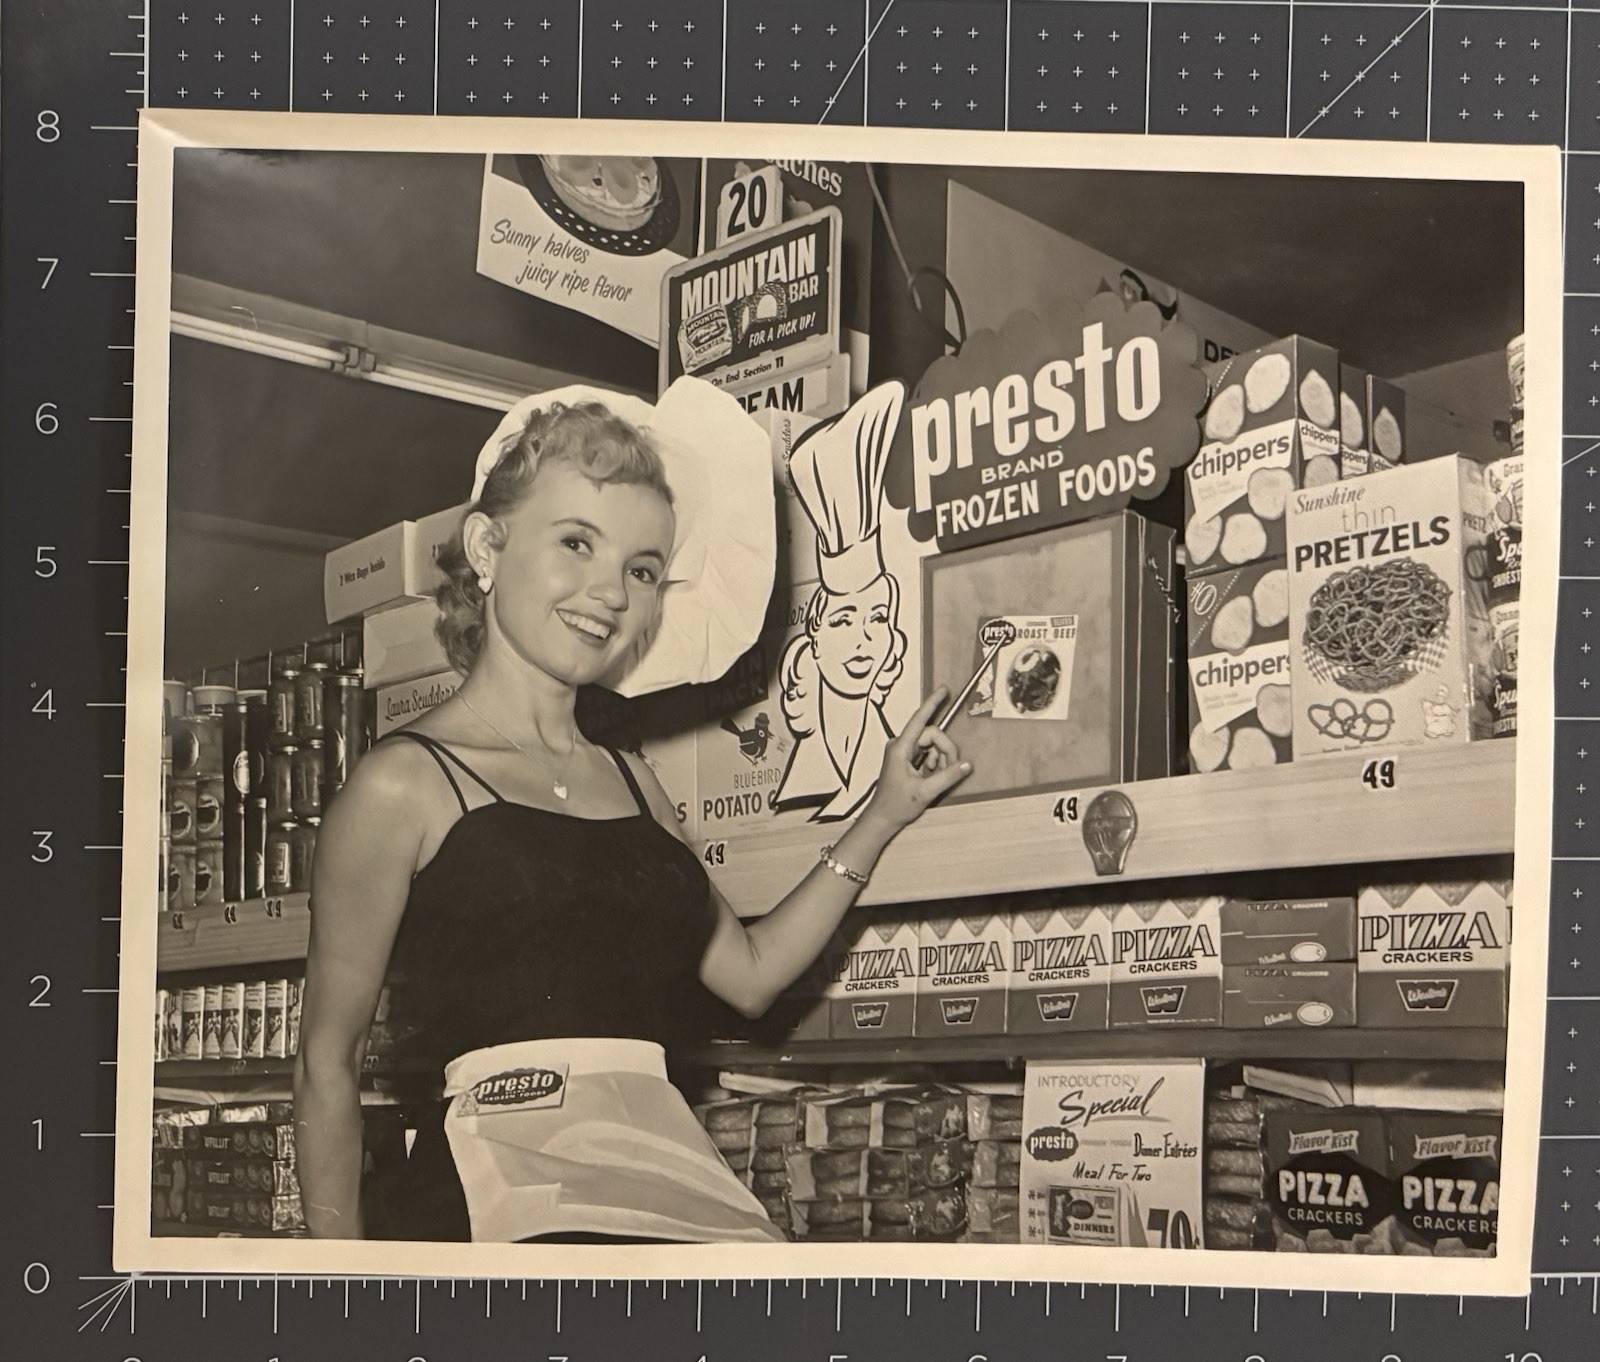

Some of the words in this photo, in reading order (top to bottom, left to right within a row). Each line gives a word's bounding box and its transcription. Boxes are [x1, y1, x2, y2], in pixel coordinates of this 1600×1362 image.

[36, 110, 60, 142] 8
[727, 175, 767, 238] 20
[490, 219, 540, 255] Sunny
[544, 235, 590, 264] halves
[38, 258, 58, 289] 7
[515, 260, 559, 289] juicy
[561, 270, 589, 295] ripe
[592, 276, 632, 302] flavor
[681, 233, 816, 320] MOUNTAIN
[789, 274, 819, 303] BAR
[749, 331, 765, 347] FOR
[767, 330, 773, 342] A
[777, 322, 797, 339] PICK
[799, 311, 816, 330] UP!
[726, 368, 739, 383] End
[743, 362, 772, 378] Section
[36, 403, 58, 434] 6
[911, 322, 1161, 513] presto
[1301, 424, 1338, 445] chippers
[981, 450, 1064, 484] BRAND
[1191, 433, 1290, 481] chippers
[936, 480, 1040, 537] FROZEN
[1059, 447, 1156, 507] FOODS
[1294, 486, 1365, 516] Sunshine
[1341, 503, 1396, 532] thin
[1295, 515, 1451, 572] PRETZELS
[36, 547, 56, 577] 5
[984, 624, 1014, 641] presto
[1017, 628, 1048, 639] ROAST
[1054, 628, 1076, 639] BEEF
[32, 689, 56, 719] 4
[384, 697, 411, 723] Laura
[733, 768, 781, 790] BLUEBIRD
[1362, 759, 1395, 789] 49
[703, 791, 762, 821] POTATO
[1053, 796, 1078, 822] 49
[32, 831, 52, 862] 3
[704, 843, 725, 865] 49
[1112, 924, 1218, 964] PIZZA
[1359, 911, 1503, 952] PIZZA
[834, 948, 915, 983] PIZZA
[918, 941, 1006, 977] PIZZA
[1013, 934, 1109, 972] PIZZA
[1129, 960, 1198, 975] CRACKERS
[1382, 951, 1474, 964] CRACKERS
[844, 979, 899, 992] CRACKERS
[932, 973, 990, 987] CRACKERS
[1028, 968, 1090, 982] CRACKERS
[29, 976, 50, 1006] 2
[477, 1072, 554, 1100] presto
[1037, 1074, 1141, 1088] INTRODUCTORY
[1058, 1076, 1165, 1128] Special
[33, 1119, 42, 1150] 1
[1030, 1133, 1074, 1154] presto
[1293, 1133, 1330, 1150] Flavor
[1331, 1130, 1355, 1148] Kist
[1419, 1139, 1462, 1157] Flavor
[1463, 1137, 1493, 1154] Kist
[1072, 1162, 1104, 1180] Meal
[1108, 1163, 1128, 1180] For
[1131, 1164, 1151, 1181] Two
[1278, 1169, 1369, 1208] PIZZA
[1402, 1175, 1498, 1215] PIZZA
[1073, 1223, 1115, 1234] DINNERS
[1287, 1207, 1363, 1226] CRACKERS
